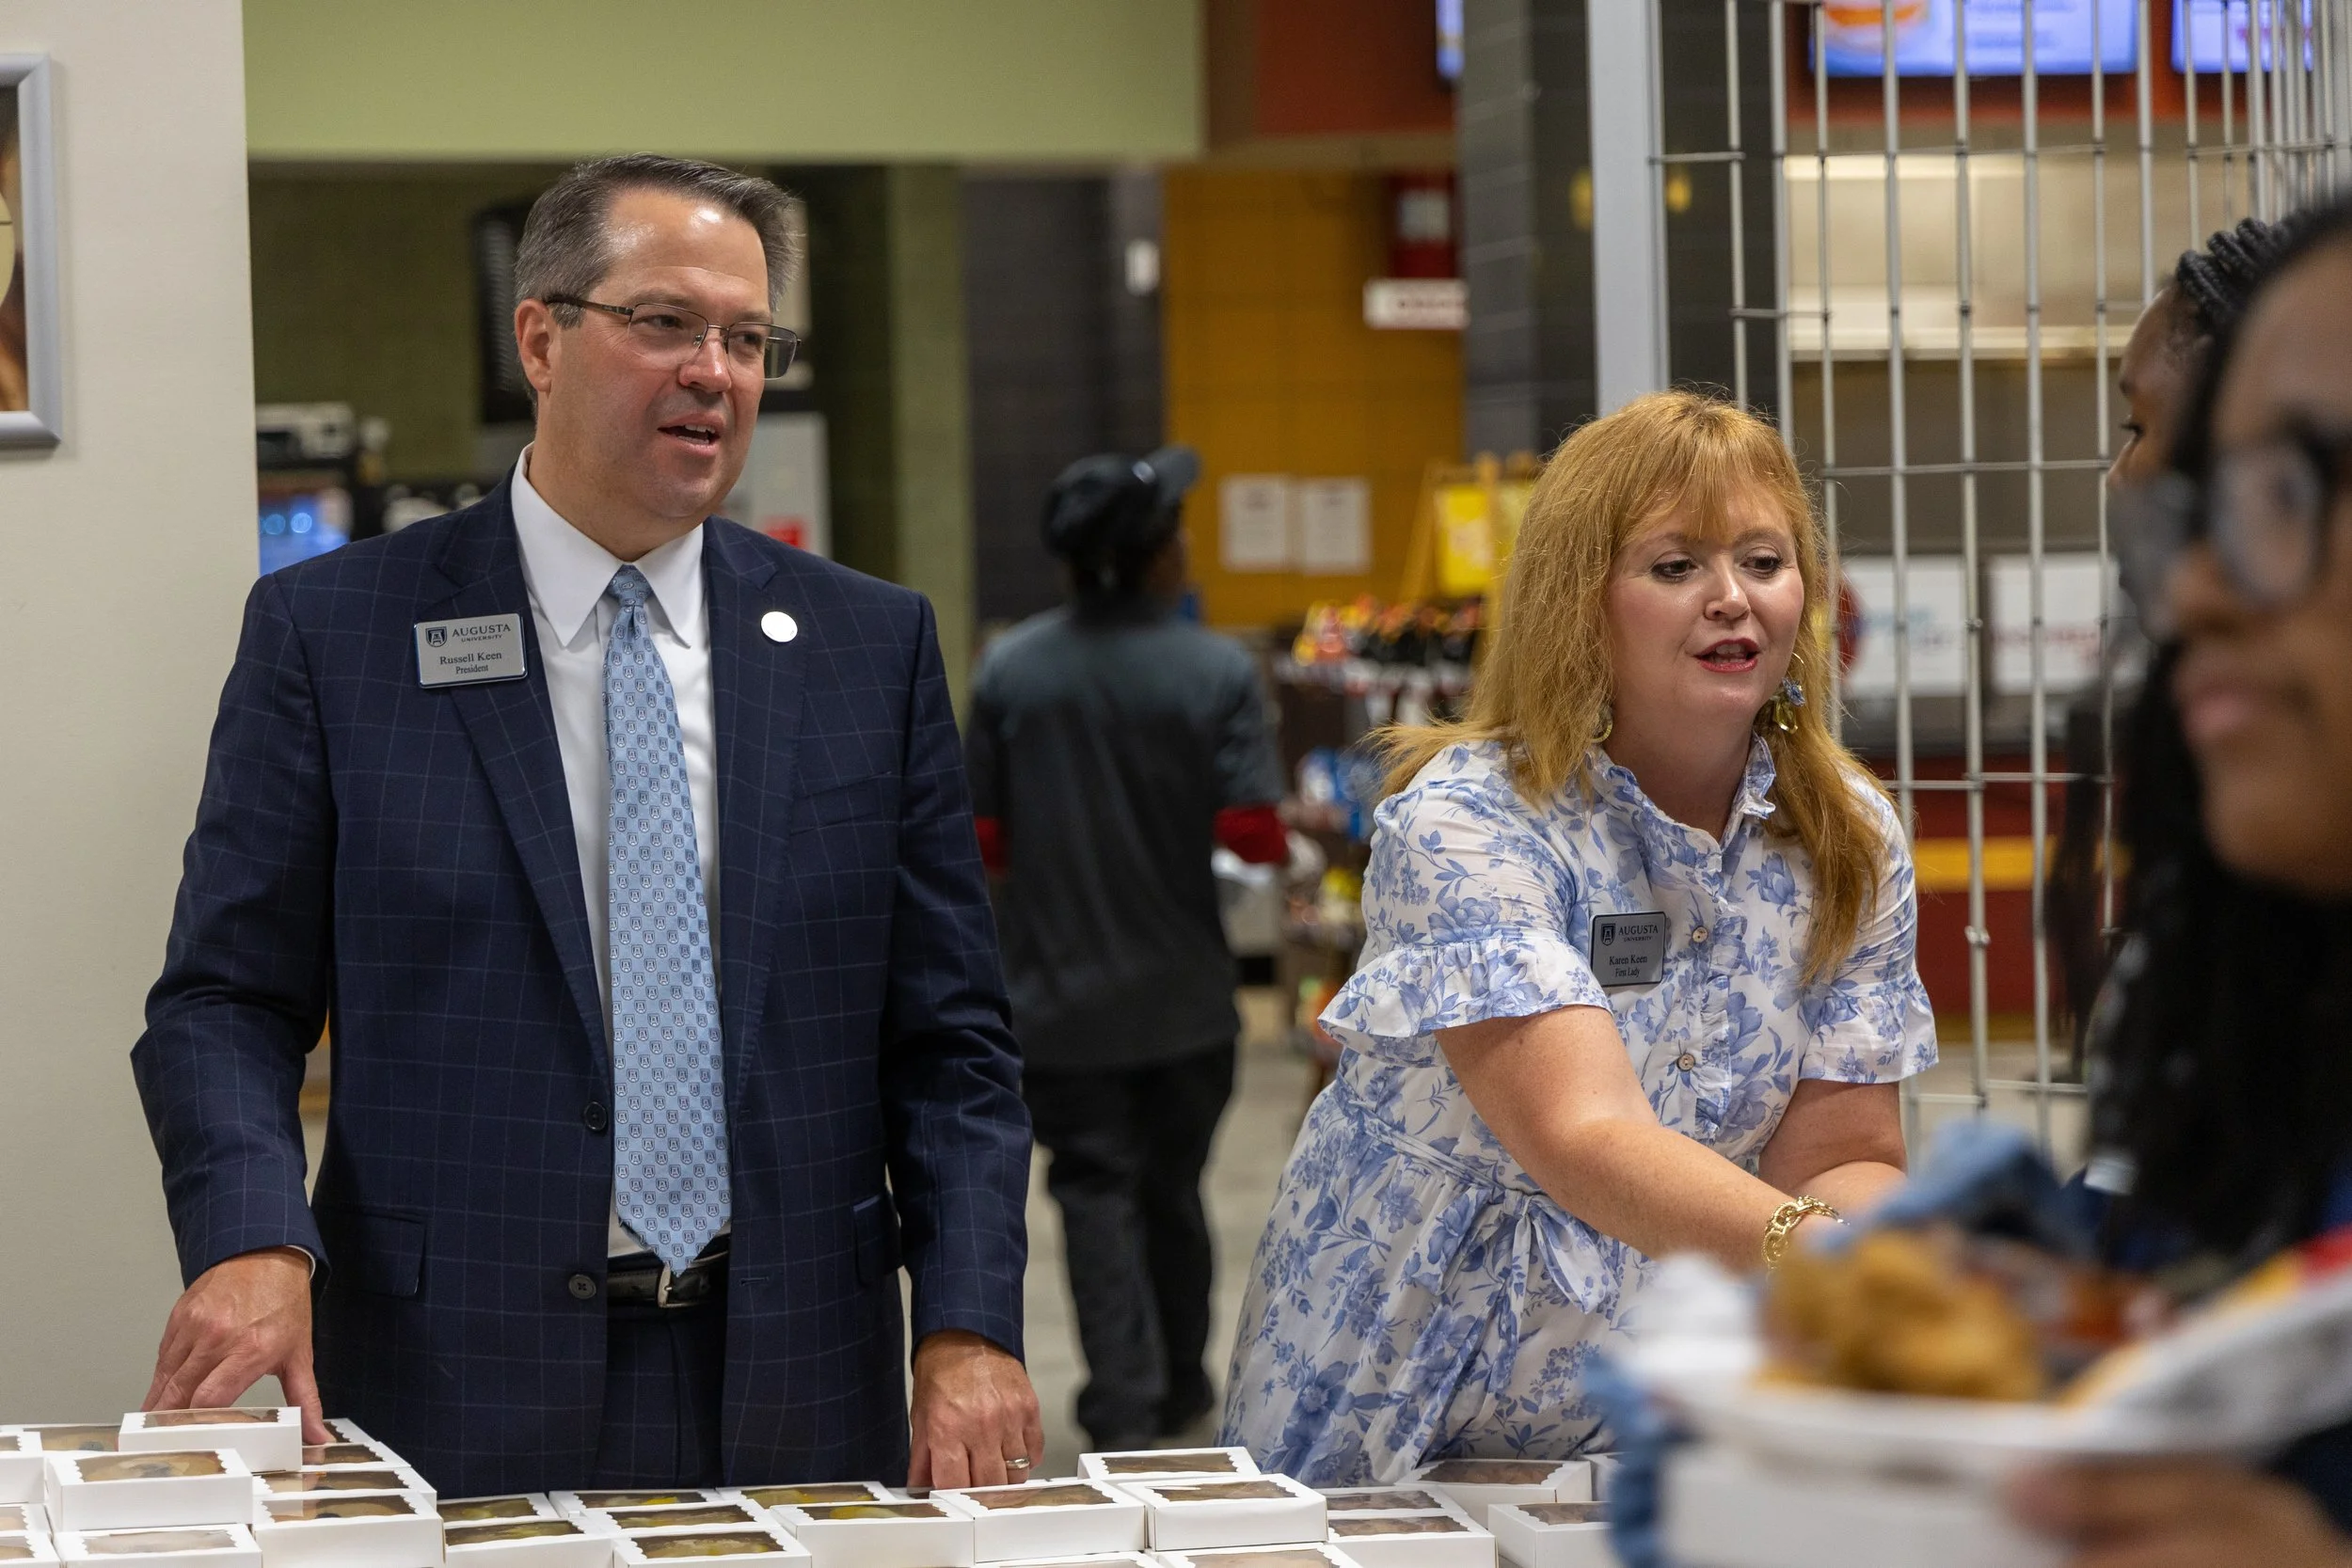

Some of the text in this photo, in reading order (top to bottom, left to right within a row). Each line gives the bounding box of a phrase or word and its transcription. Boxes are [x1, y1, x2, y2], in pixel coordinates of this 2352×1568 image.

[452, 624, 511, 638] AUGUSTA
[461, 634, 502, 642] UNIVERSITY
[439, 652, 502, 665] Russell Keen
[455, 664, 489, 674] President
[1618, 924, 1659, 936] AUGUSTA
[1609, 954, 1647, 965] Karen Keen
[1628, 967, 1640, 977] Lady
